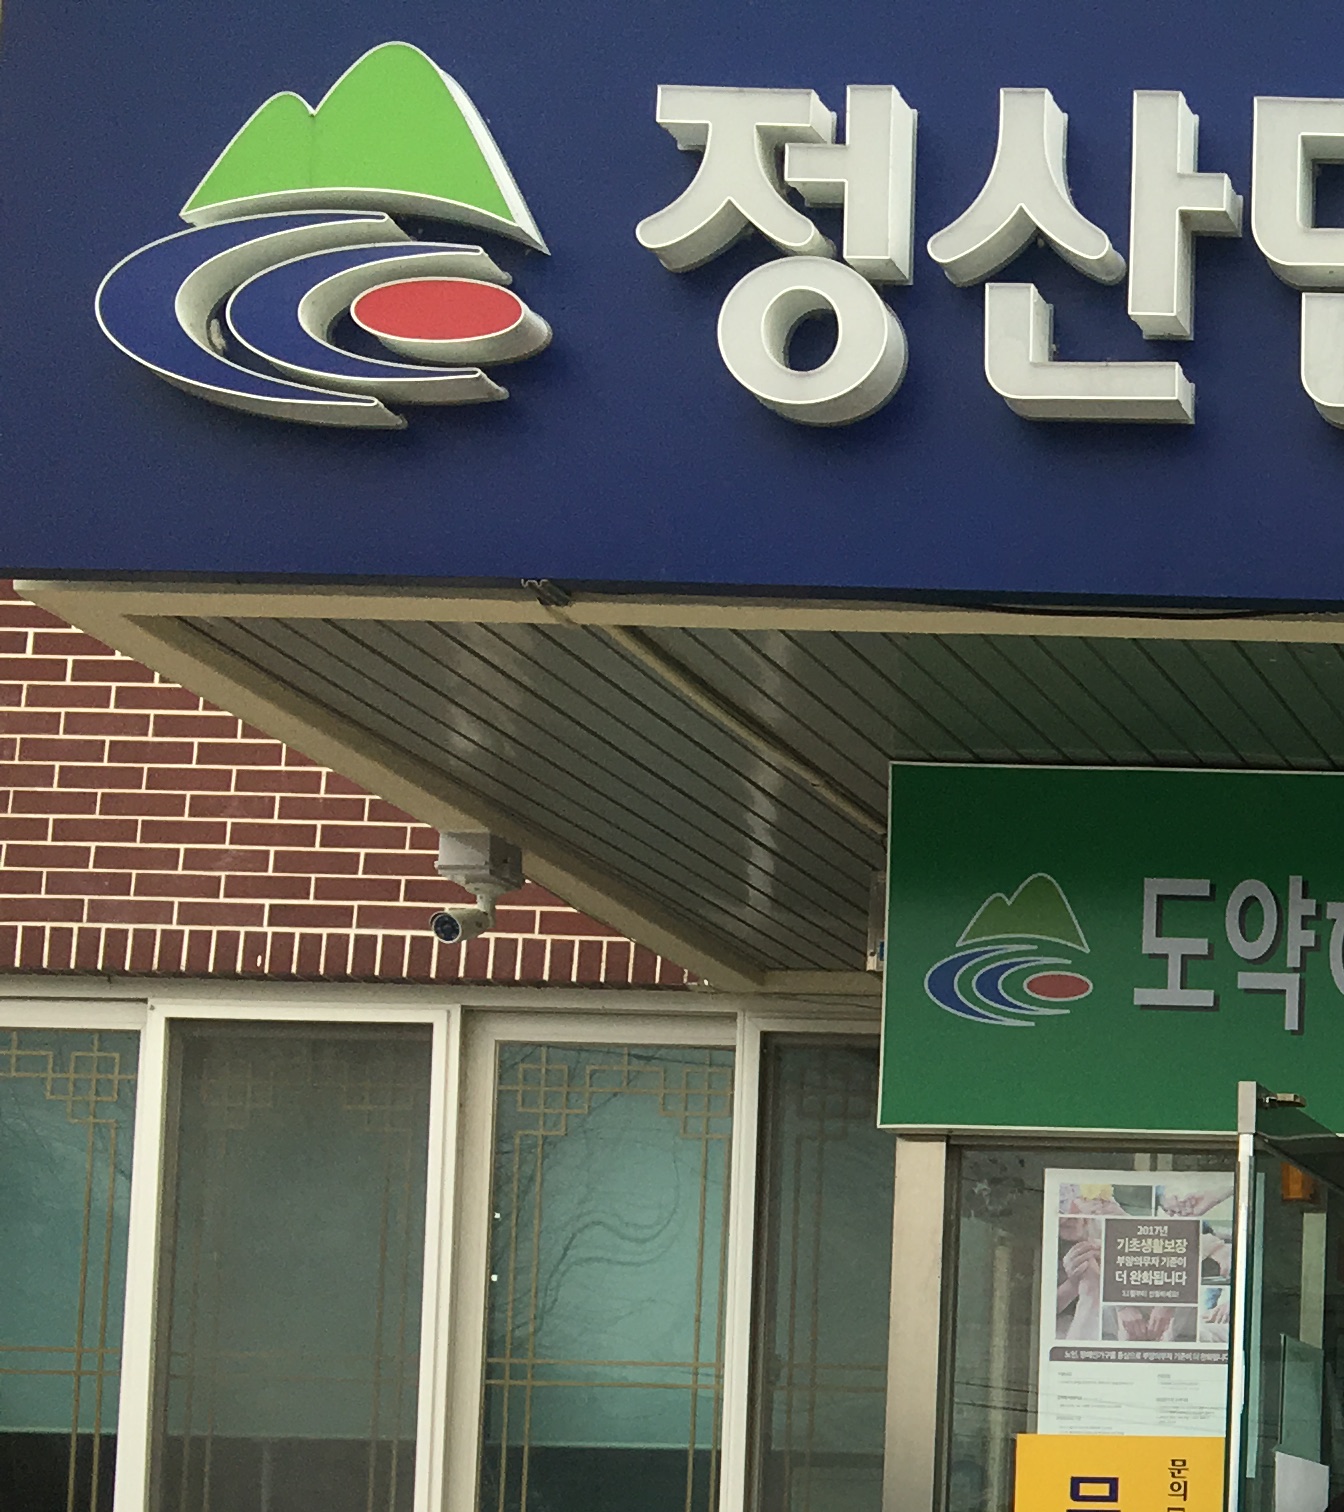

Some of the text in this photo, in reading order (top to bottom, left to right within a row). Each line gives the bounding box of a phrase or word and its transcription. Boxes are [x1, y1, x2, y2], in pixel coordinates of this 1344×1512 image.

[1136, 1225, 1168, 1237] 2017년
[1116, 1237, 1189, 1254] 기초생활보장
[1115, 1270, 1188, 1286] 더 완화됩니다
[1167, 1458, 1190, 1502] 문의
